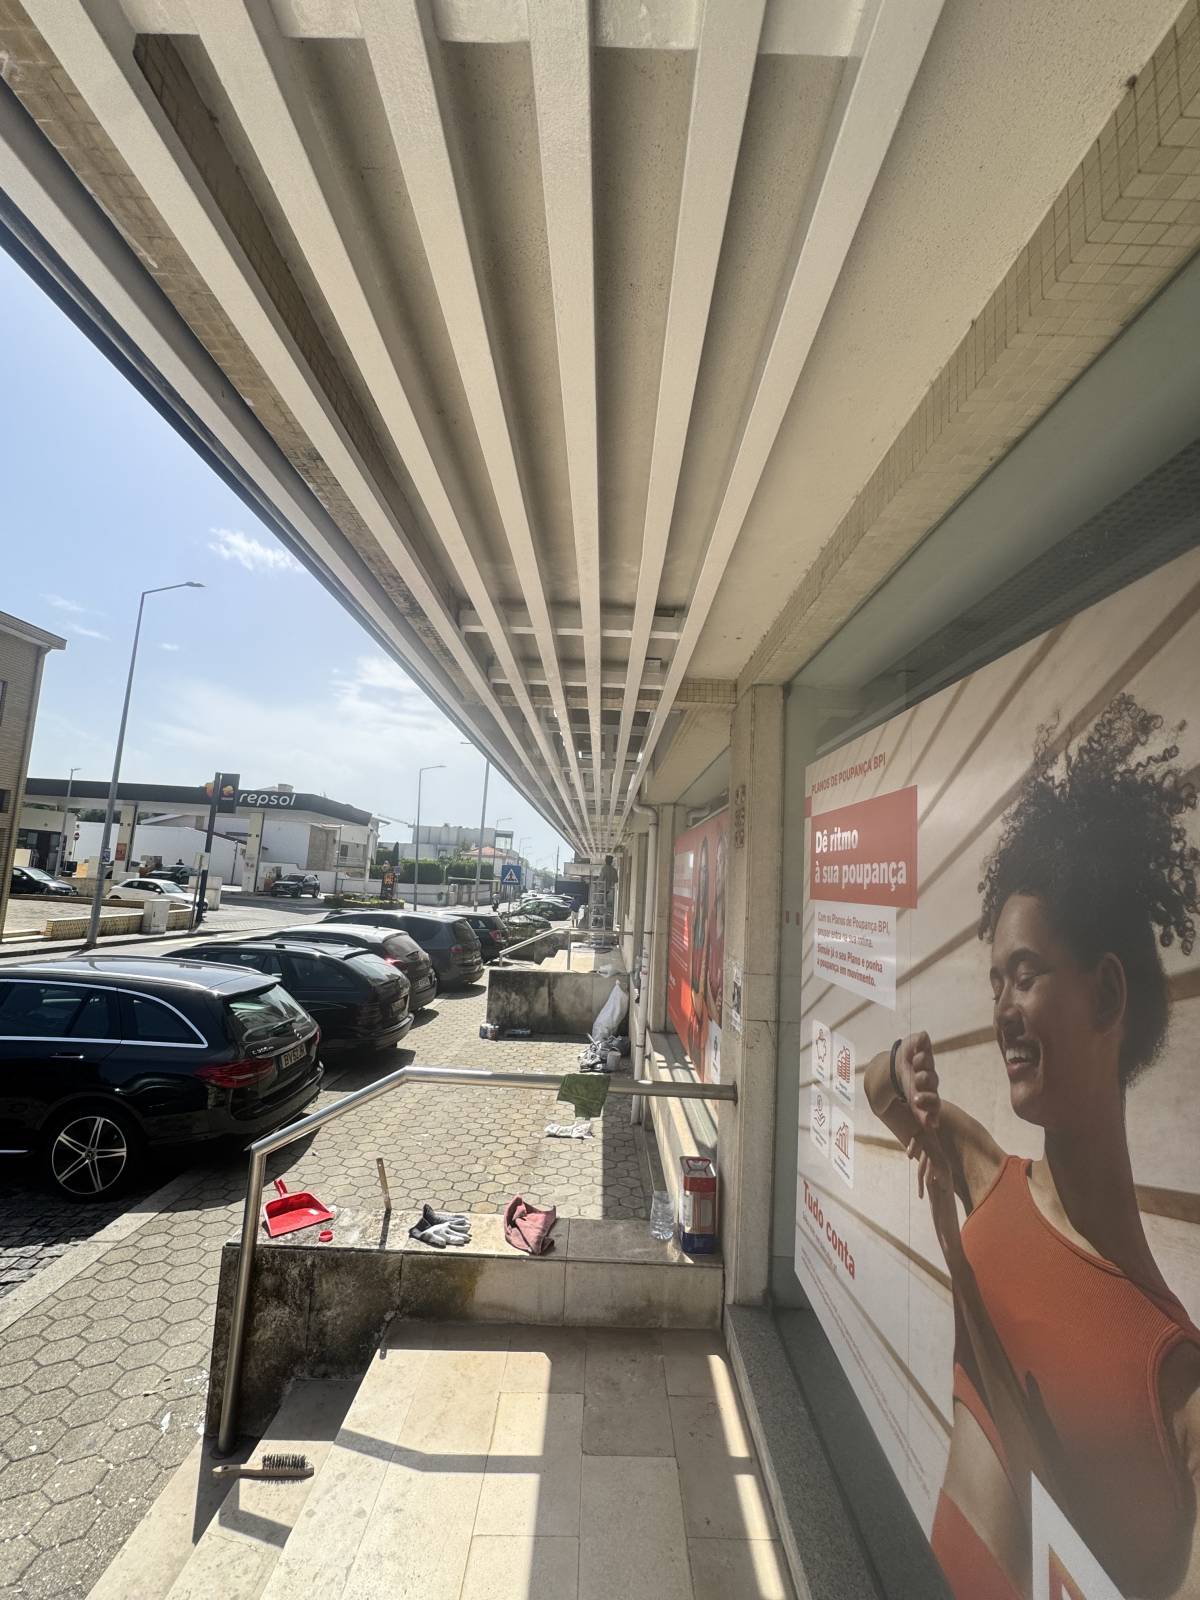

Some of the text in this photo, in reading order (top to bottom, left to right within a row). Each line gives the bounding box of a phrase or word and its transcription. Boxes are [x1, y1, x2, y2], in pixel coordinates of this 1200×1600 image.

[811, 751, 886, 796] PLANOS DE POUPANÇA BPI
[239, 793, 297, 807] repsol
[815, 827, 859, 854] Dê ritmo
[814, 860, 907, 891] à sua poupança
[852, 916, 877, 934] Poupança
[839, 951, 847, 961] seu
[847, 951, 861, 966] Plano
[865, 959, 883, 973] ponha
[803, 1179, 824, 1230] Tudo
[826, 1221, 855, 1280] conta
